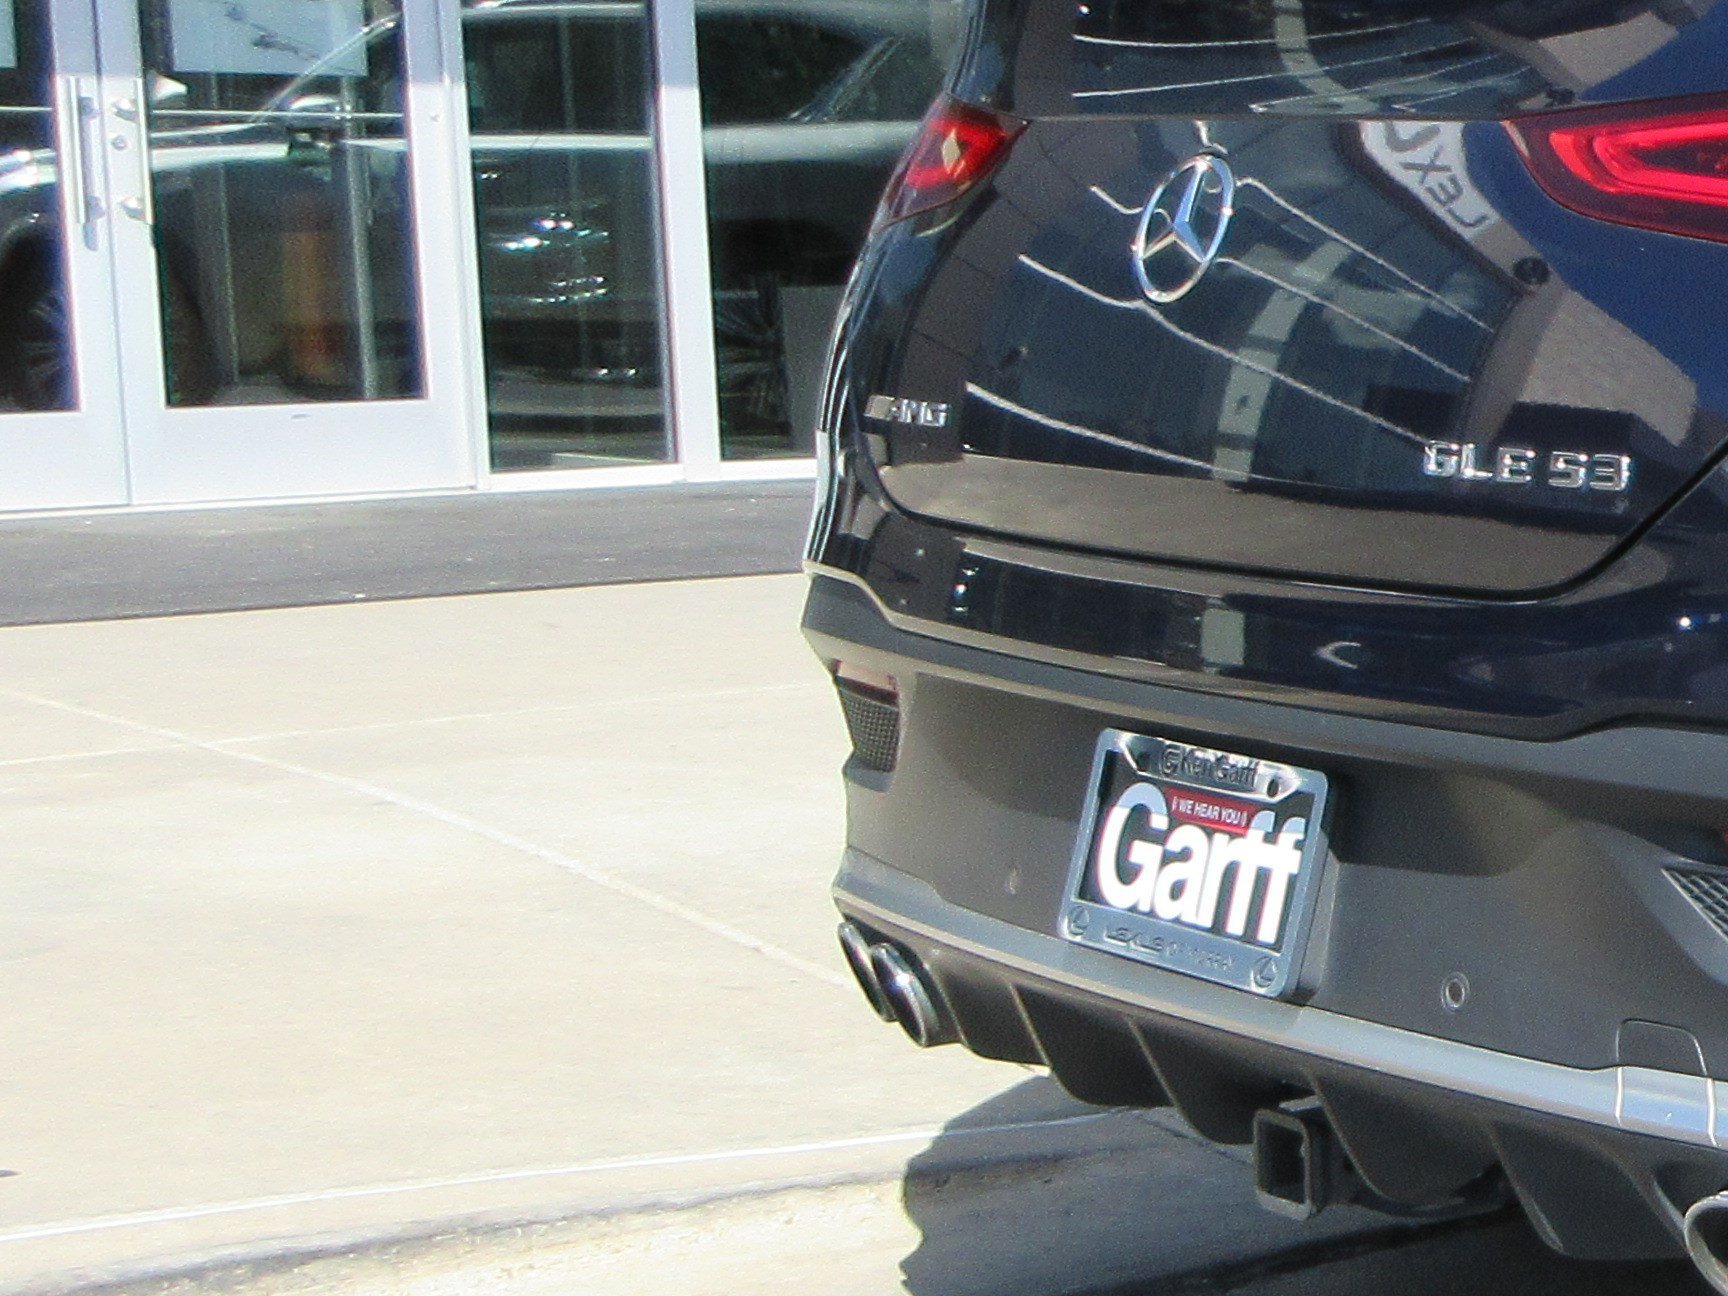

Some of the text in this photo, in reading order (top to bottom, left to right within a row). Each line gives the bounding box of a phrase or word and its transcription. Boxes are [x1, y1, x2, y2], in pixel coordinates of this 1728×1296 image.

[1424, 440, 1631, 492] GLE 53
[1178, 797, 1242, 826] WE HEAR YOU
[1097, 782, 1306, 946] Garff
